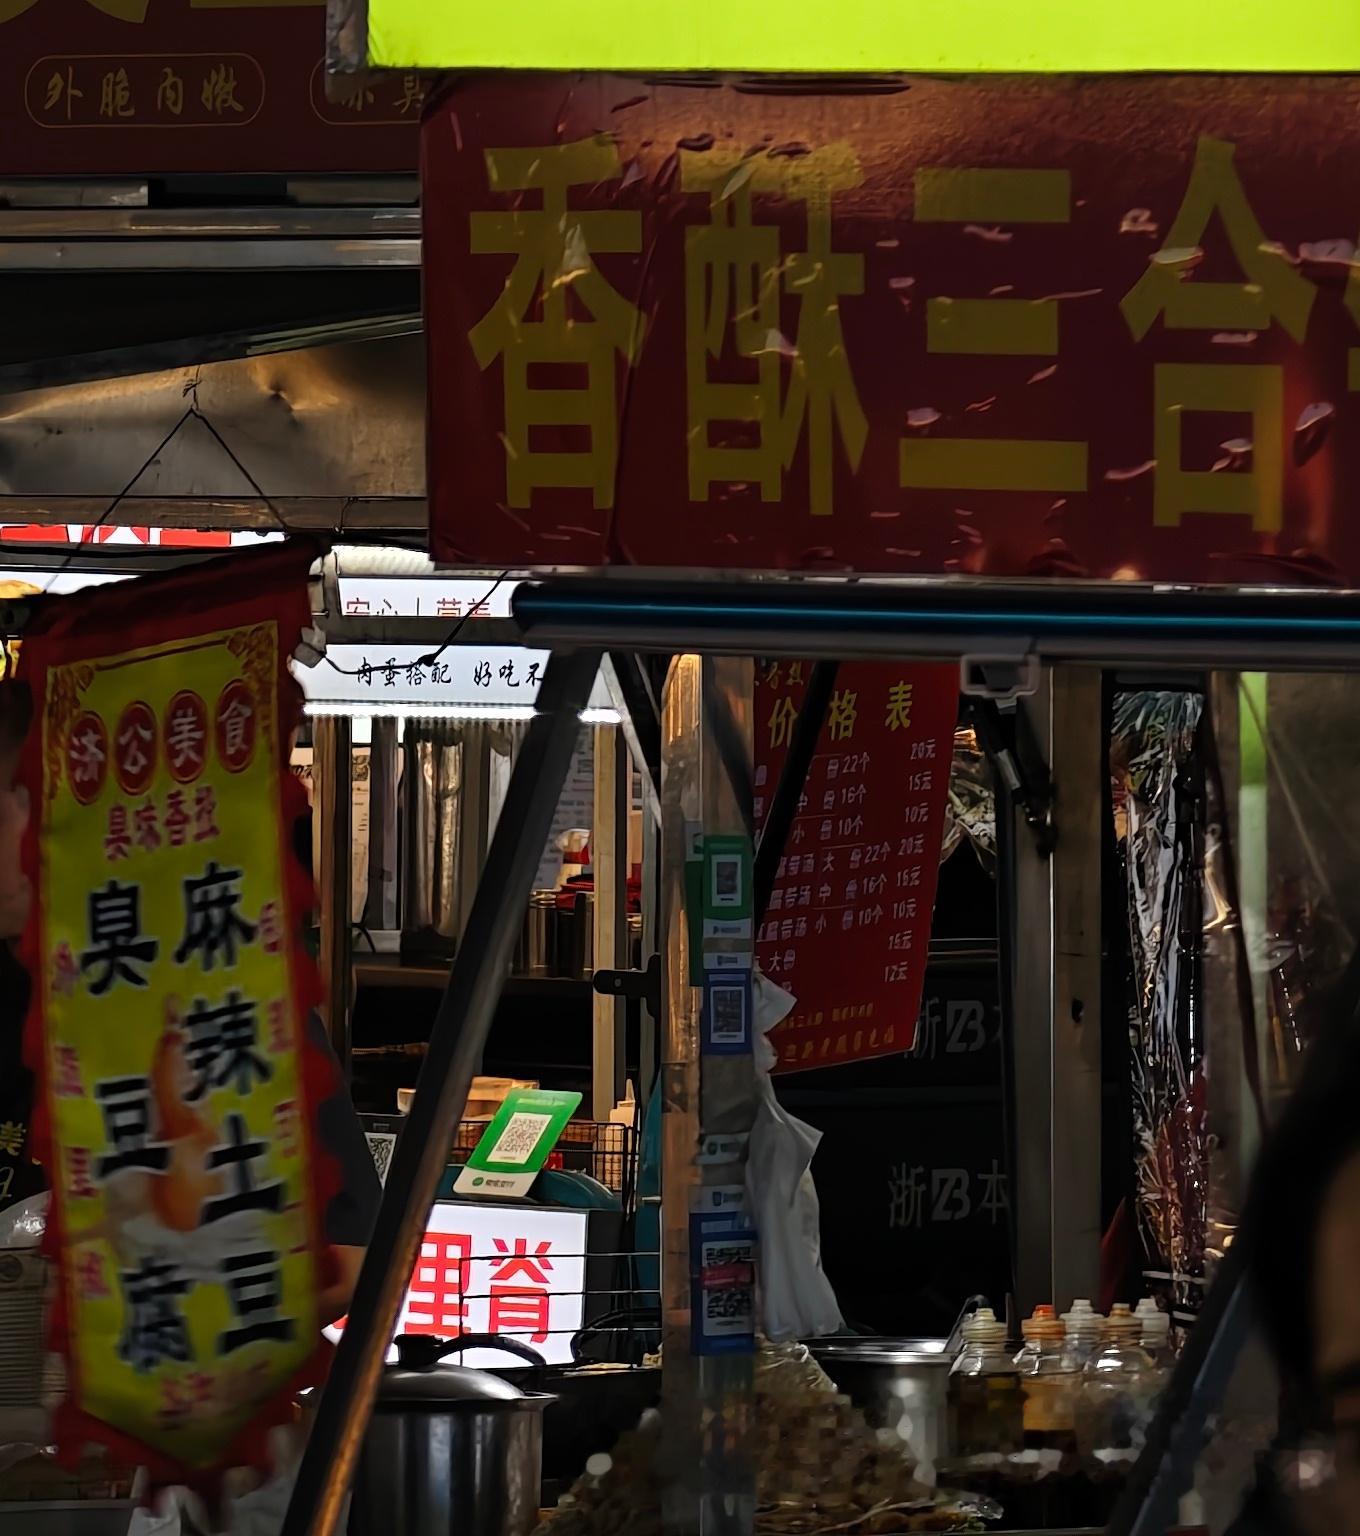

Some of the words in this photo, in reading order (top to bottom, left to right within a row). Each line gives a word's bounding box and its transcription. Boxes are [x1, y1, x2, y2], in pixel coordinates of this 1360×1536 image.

[469, 132, 1360, 536] 香酥三合
[768, 680, 913, 750] 价格表
